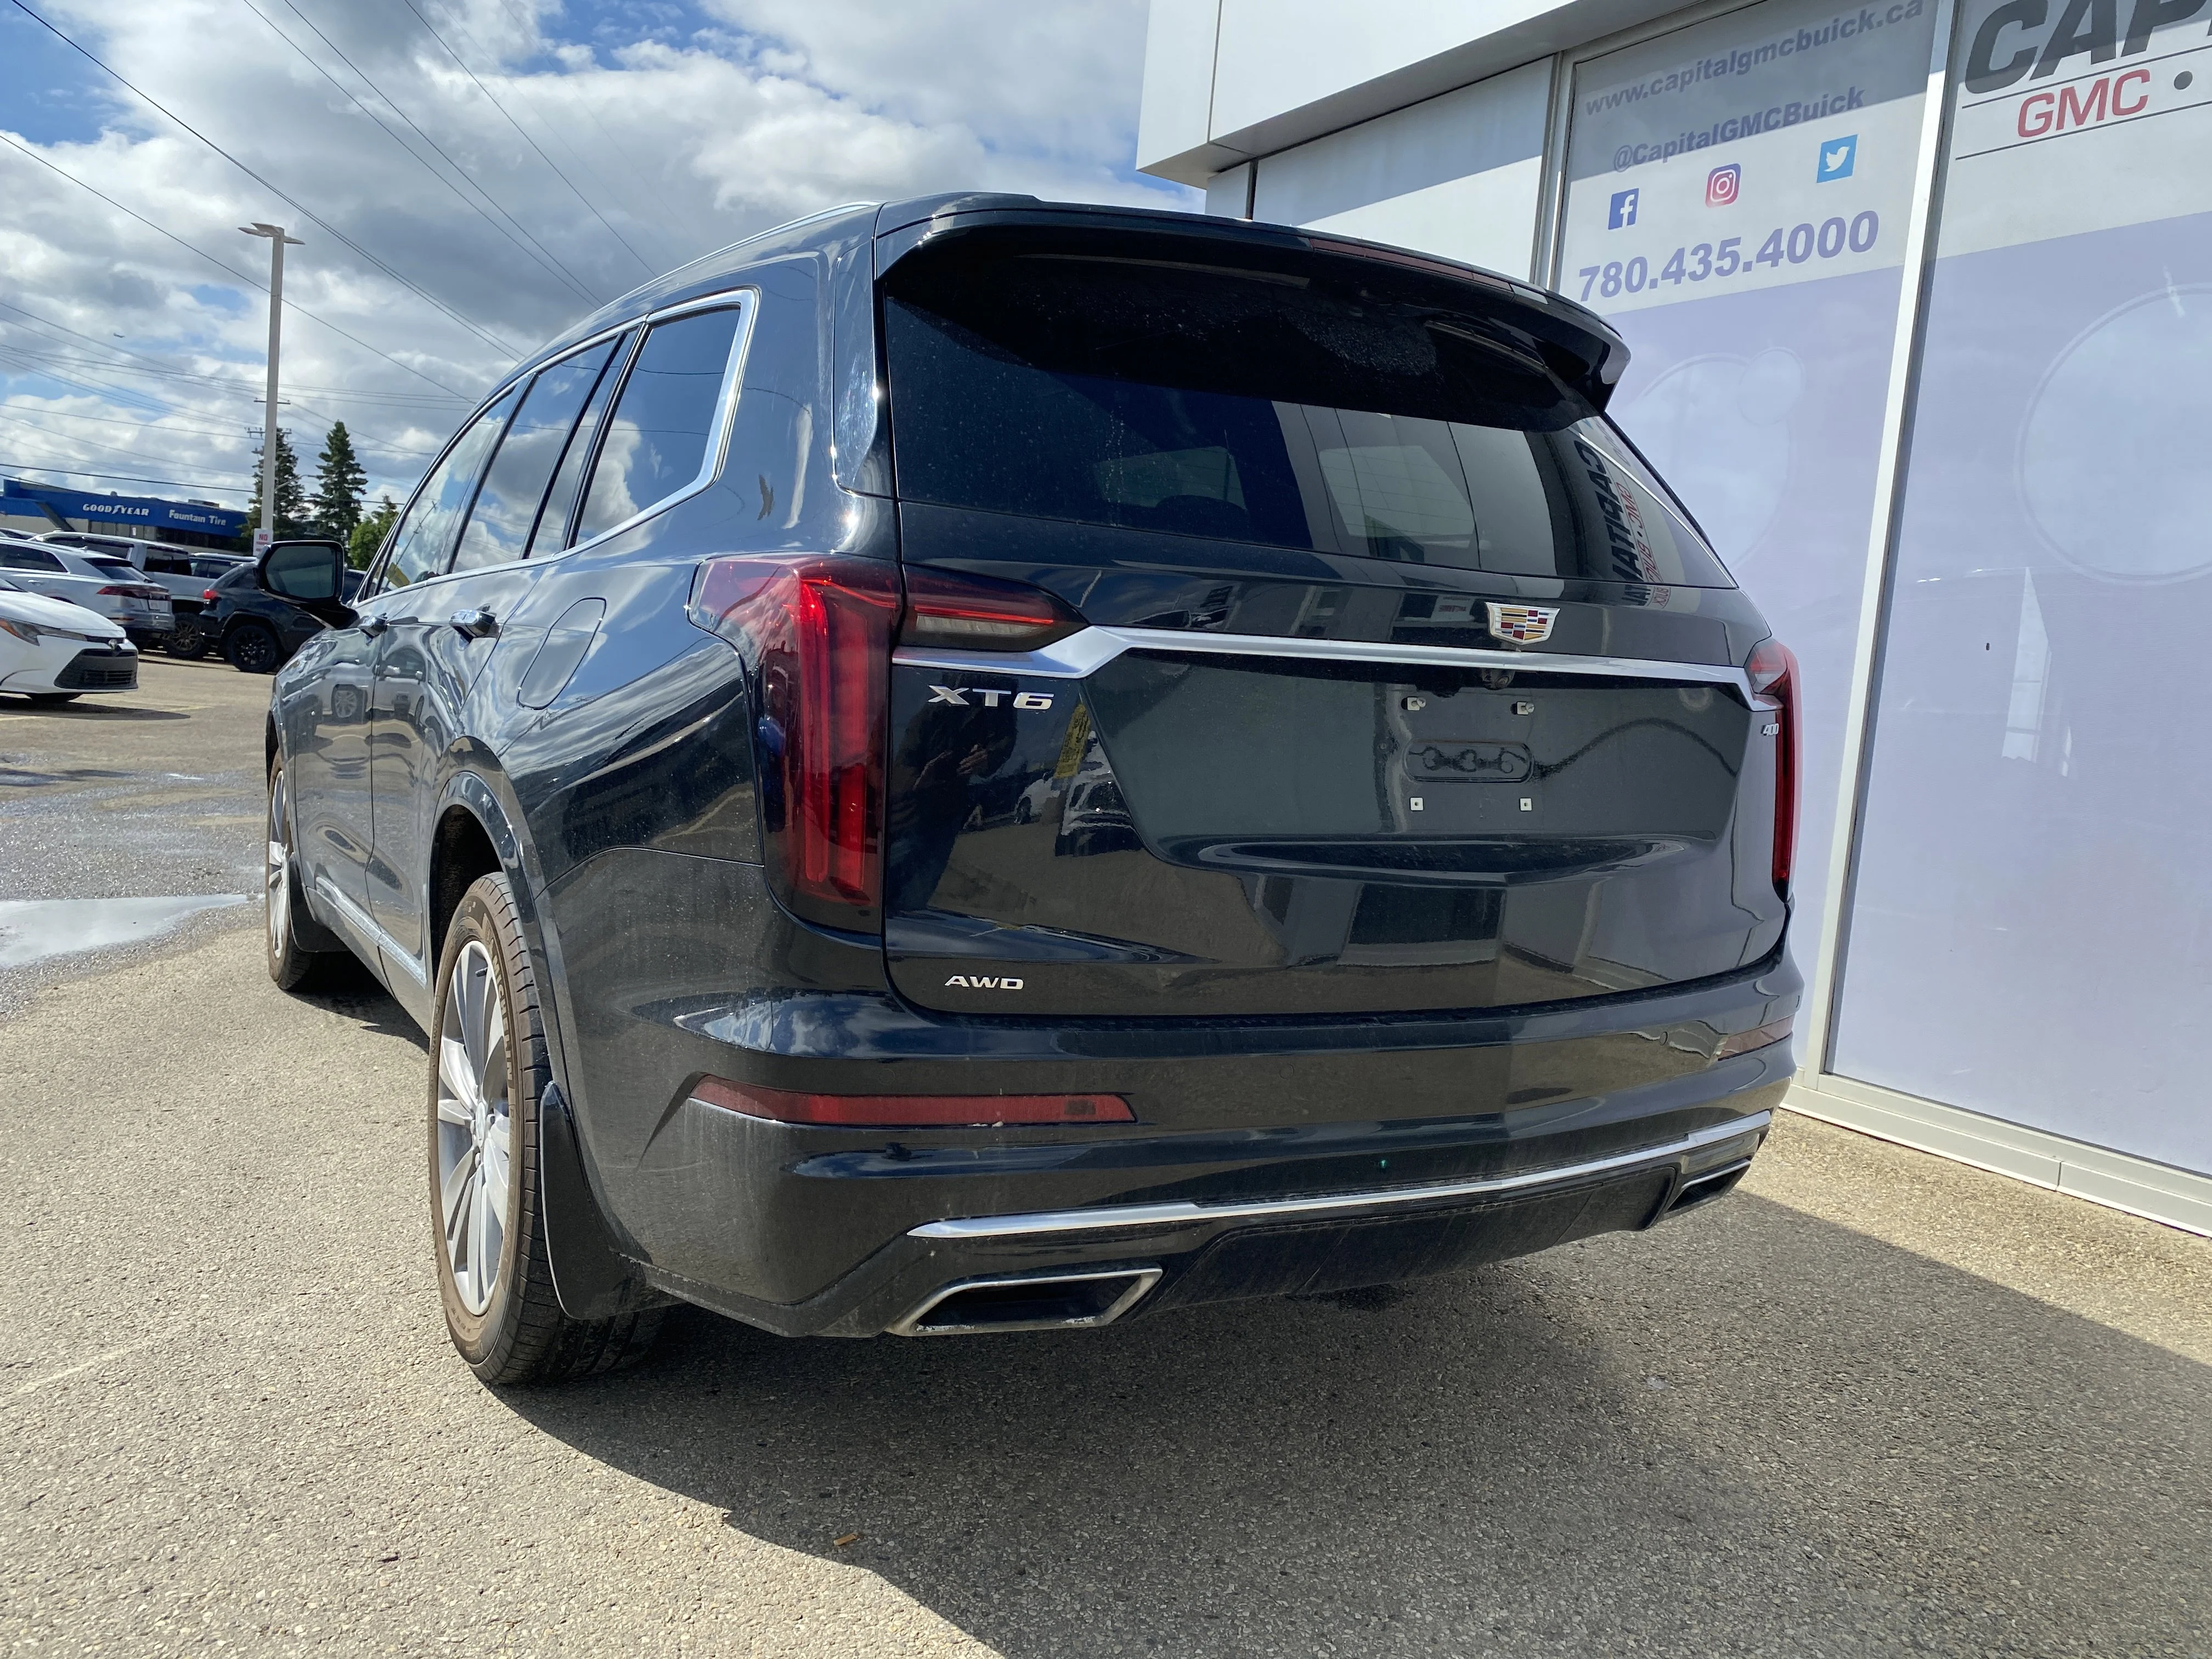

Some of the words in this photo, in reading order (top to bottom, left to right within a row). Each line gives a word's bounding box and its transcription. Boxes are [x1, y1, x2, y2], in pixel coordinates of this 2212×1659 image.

[1585, 0, 1922, 116] www.capitalgmcbuick.ca
[1965, 0, 2212, 94] CAP
[1613, 86, 1866, 173] @CapitalGMCBuick
[2017, 69, 2151, 137] GMC
[1579, 210, 1880, 302] 780.435.4000
[83, 504, 149, 516] GOODYEAR
[169, 509, 206, 523] Fountain
[209, 515, 226, 526] Tire
[928, 685, 1054, 710] XT6
[492, 955, 514, 1081] MICHELIN
[944, 975, 1024, 990] AWD
